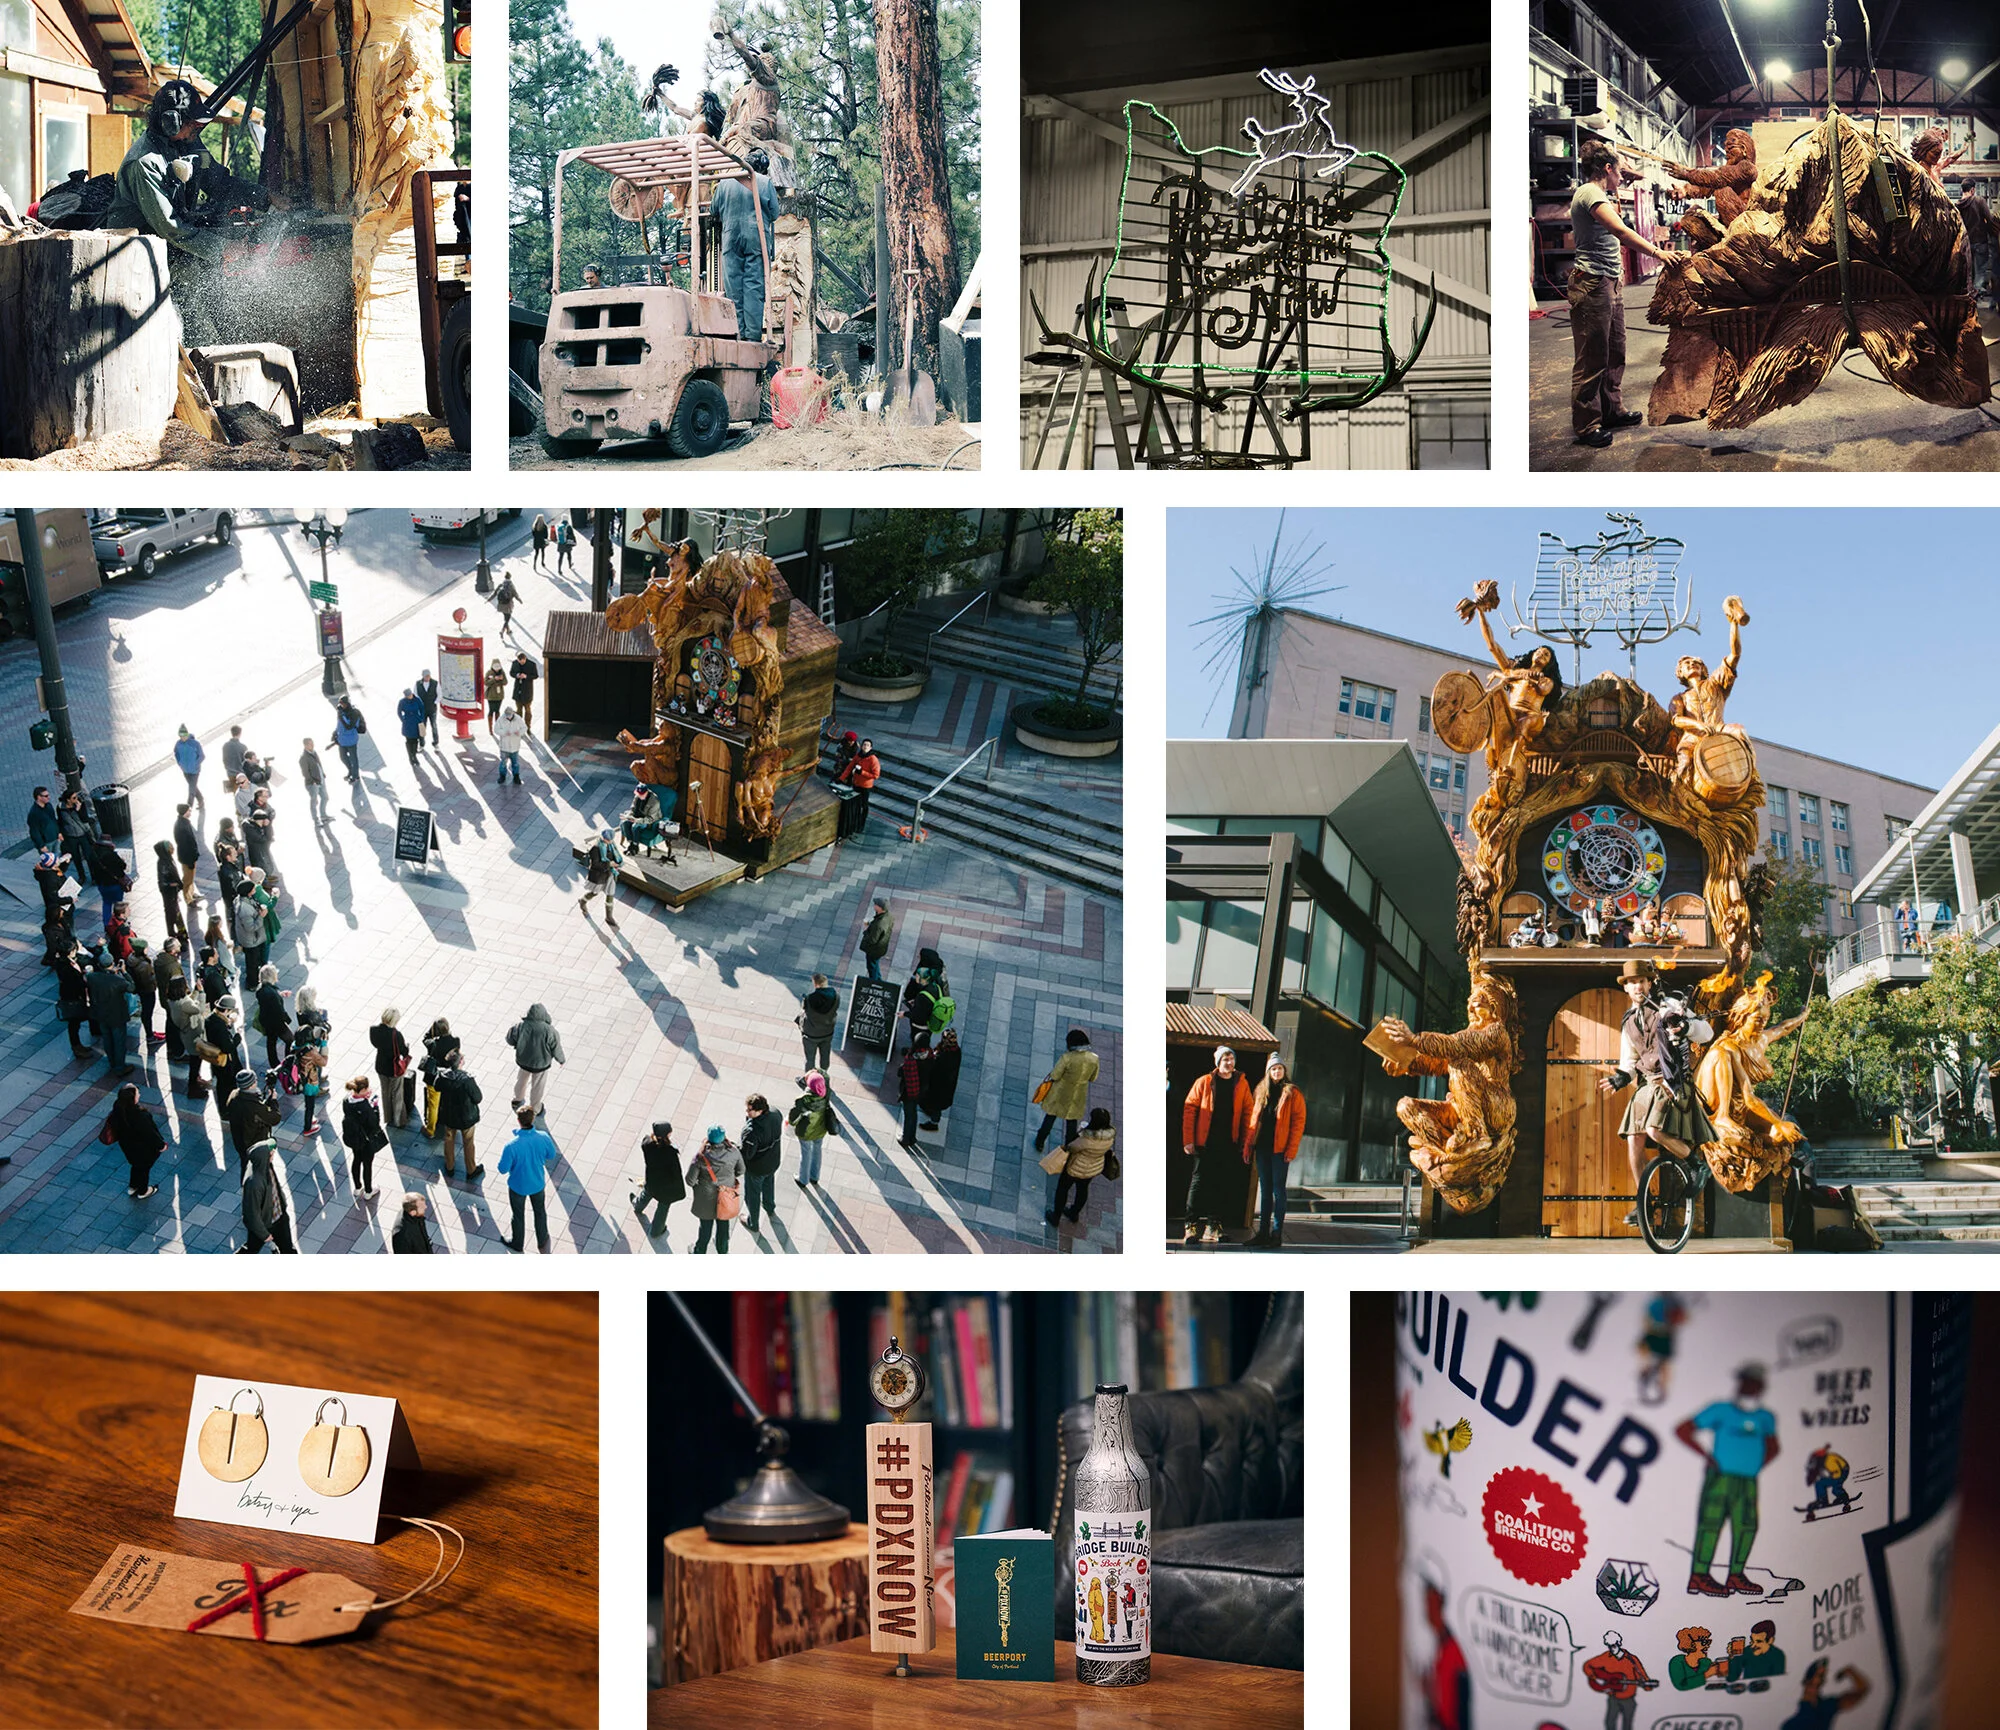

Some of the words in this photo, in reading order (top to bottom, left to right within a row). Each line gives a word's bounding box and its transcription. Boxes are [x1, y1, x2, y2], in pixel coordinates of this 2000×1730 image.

[1151, 168, 1354, 305] Portland
[56, 533, 82, 550] World
[1553, 546, 1658, 609] Portland
[866, 995, 883, 1007] THE
[1396, 1291, 1660, 1504] UILDER
[237, 1480, 273, 1518] betsy
[875, 1437, 917, 1639] #PDXNOW
[1494, 1510, 1575, 1544] COALITION
[1494, 1522, 1549, 1548] BREWING
[1550, 1540, 1575, 1554] CO.
[115, 1554, 151, 1591] Handmade
[1812, 1573, 1864, 1619] MORE
[1521, 1608, 1559, 1643] DARK
[1812, 1604, 1867, 1653] BEER
[984, 1652, 1027, 1661] BEERPORT
